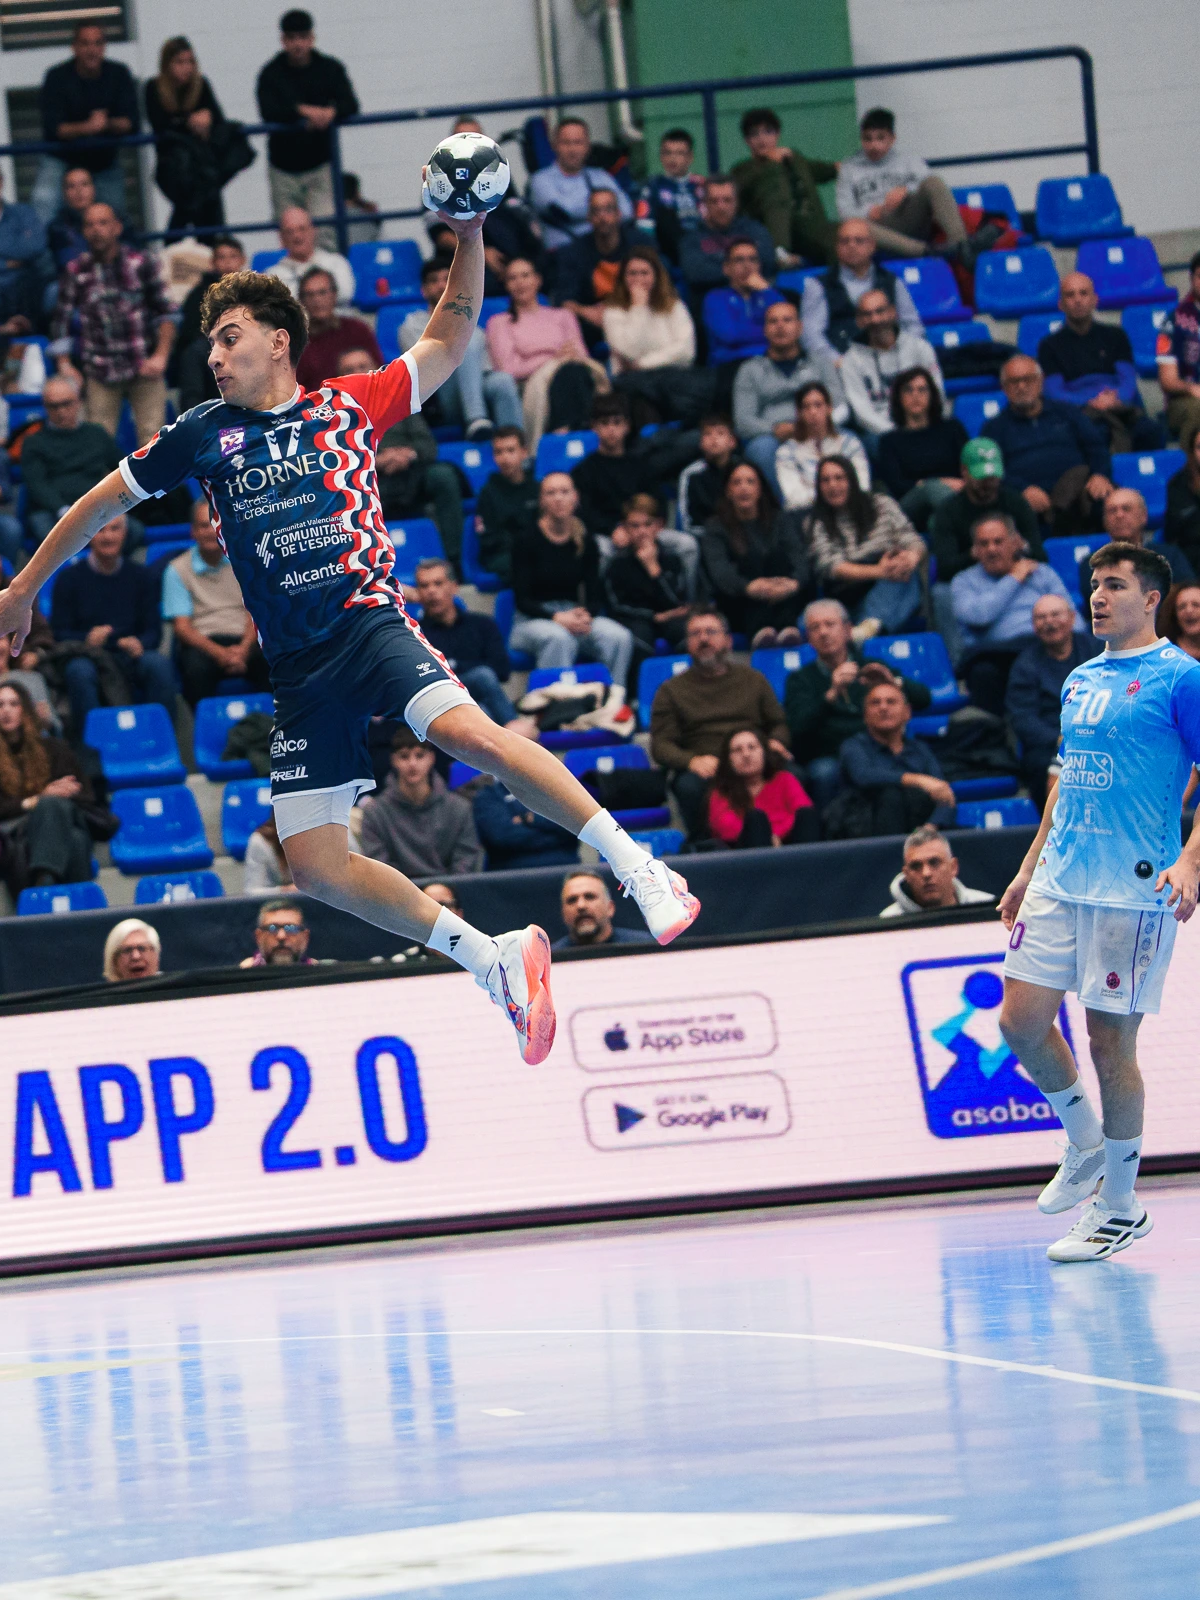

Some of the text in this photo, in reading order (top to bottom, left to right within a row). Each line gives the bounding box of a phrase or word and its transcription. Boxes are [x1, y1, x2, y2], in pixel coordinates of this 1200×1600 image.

[263, 420, 304, 461] 17
[224, 450, 343, 498] HORNEO
[272, 514, 344, 536] Comunitat Valenciana
[273, 522, 345, 548] COMUNITAT
[281, 533, 353, 557] DE L'ESPORT
[280, 562, 345, 589] Alicante
[288, 577, 341, 596] Sports Destination
[1071, 688, 1113, 726] 10
[640, 1027, 746, 1053] App Store
[13, 1056, 215, 1197] APP
[250, 1035, 428, 1173] 2.0
[657, 1104, 769, 1129] Google Play
